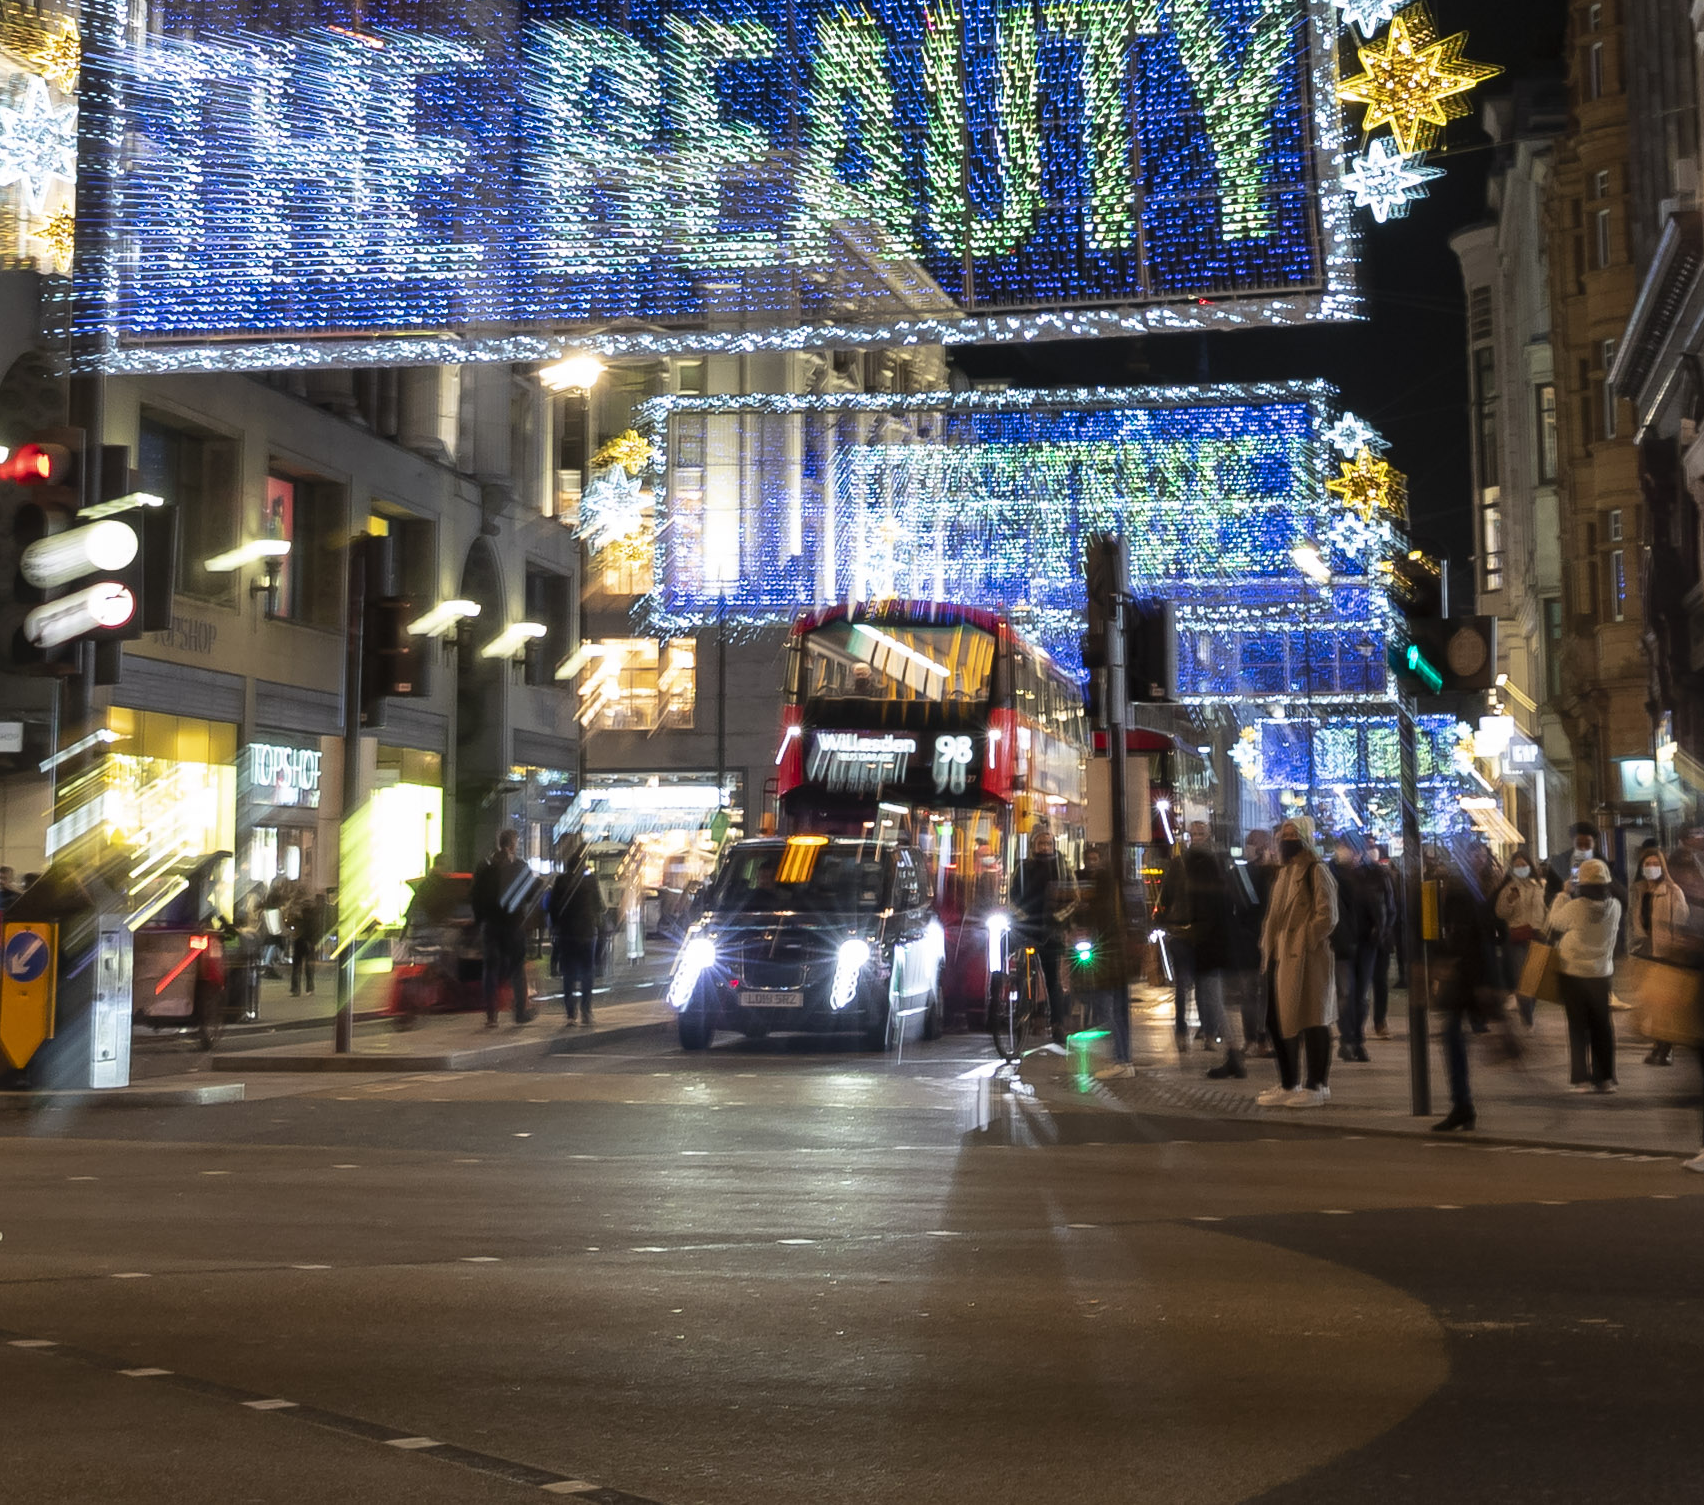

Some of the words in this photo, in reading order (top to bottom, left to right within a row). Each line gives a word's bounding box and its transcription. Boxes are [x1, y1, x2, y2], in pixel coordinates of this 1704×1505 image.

[133, 29, 485, 282] THE
[817, 733, 916, 753] Willesden
[935, 735, 973, 764] 98
